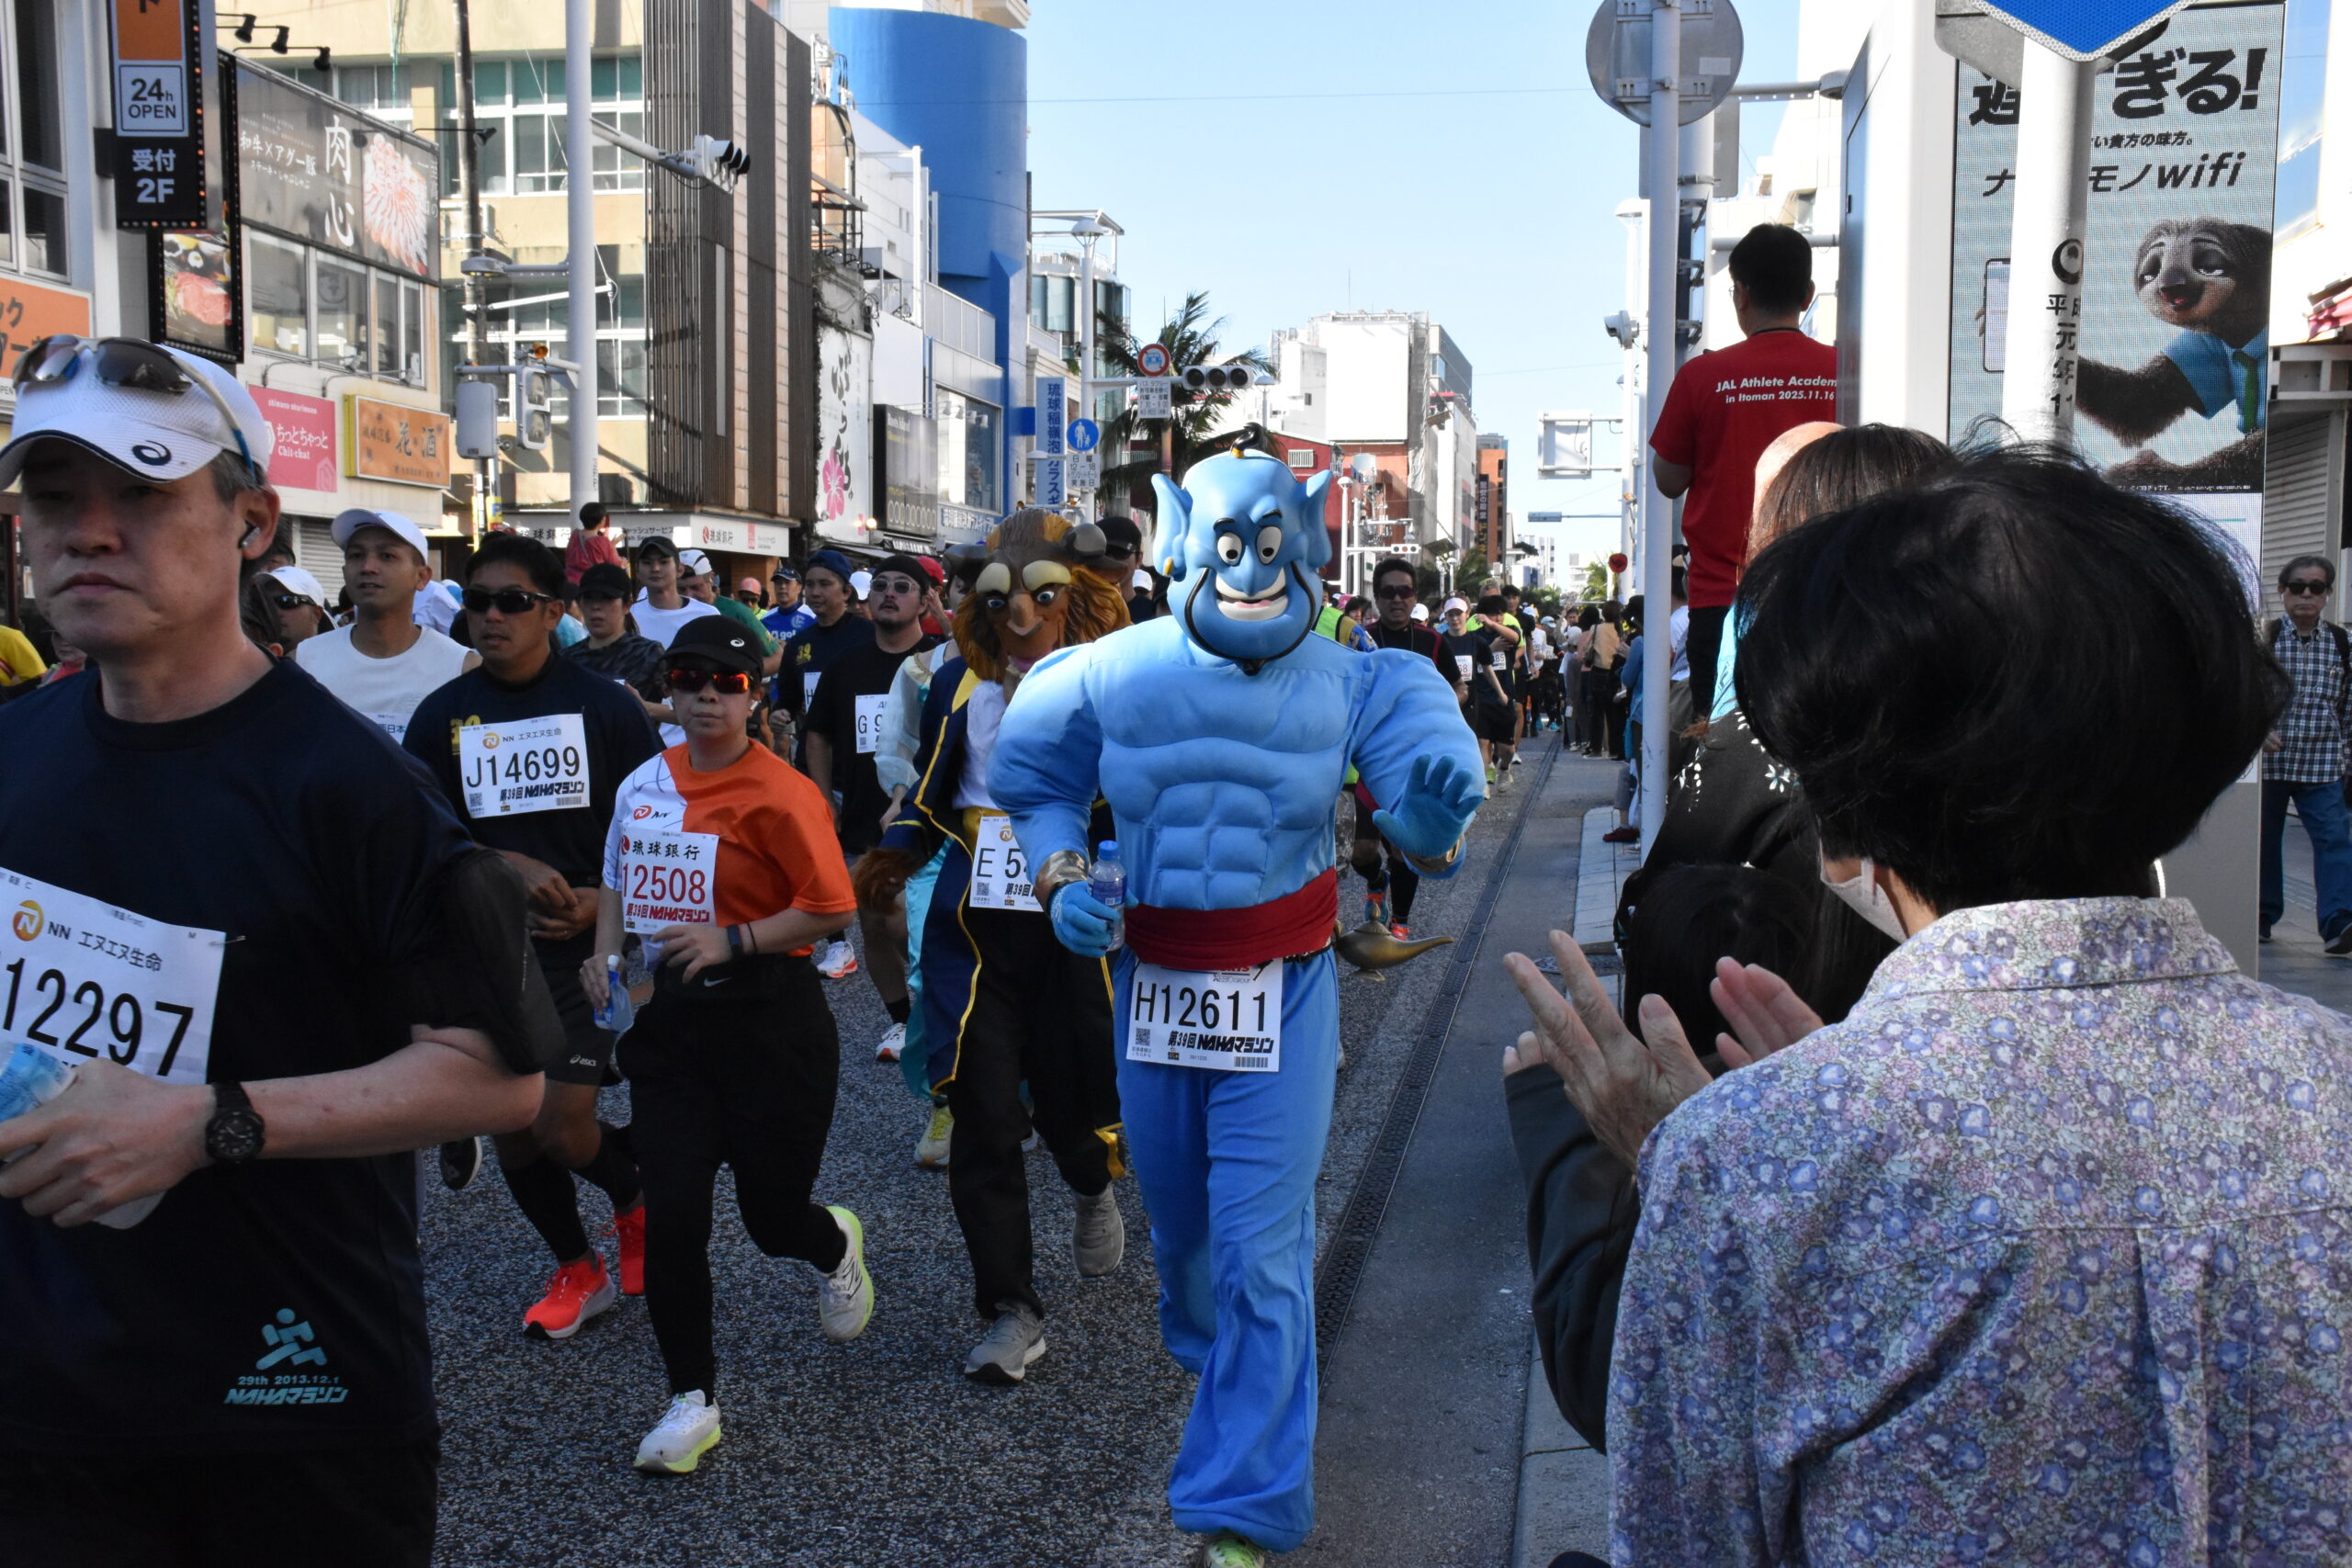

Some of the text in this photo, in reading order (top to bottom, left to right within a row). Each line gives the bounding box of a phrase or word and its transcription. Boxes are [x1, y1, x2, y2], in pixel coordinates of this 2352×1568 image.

[129, 104, 176, 118] OPEN
[2091, 130, 2192, 149] い貴方の味方。
[132, 148, 175, 172] 受付
[136, 178, 175, 203] 2F
[1715, 379, 1736, 392] JAL
[1740, 377, 1784, 389] Athlete
[1725, 390, 1835, 403] in Itoman 2025.11.16
[277, 423, 329, 448] ちっとちゃっと
[518, 728, 562, 740] エヌエヌ生命
[467, 746, 580, 788] J14699
[632, 839, 700, 861] 琉球銀行
[48, 920, 163, 972] NN エヌエヌ生命
[1135, 981, 1265, 1032] H12611
[237, 1375, 339, 1385] 29th 2013.12.1
[223, 1386, 349, 1404] NAHAマラソン
